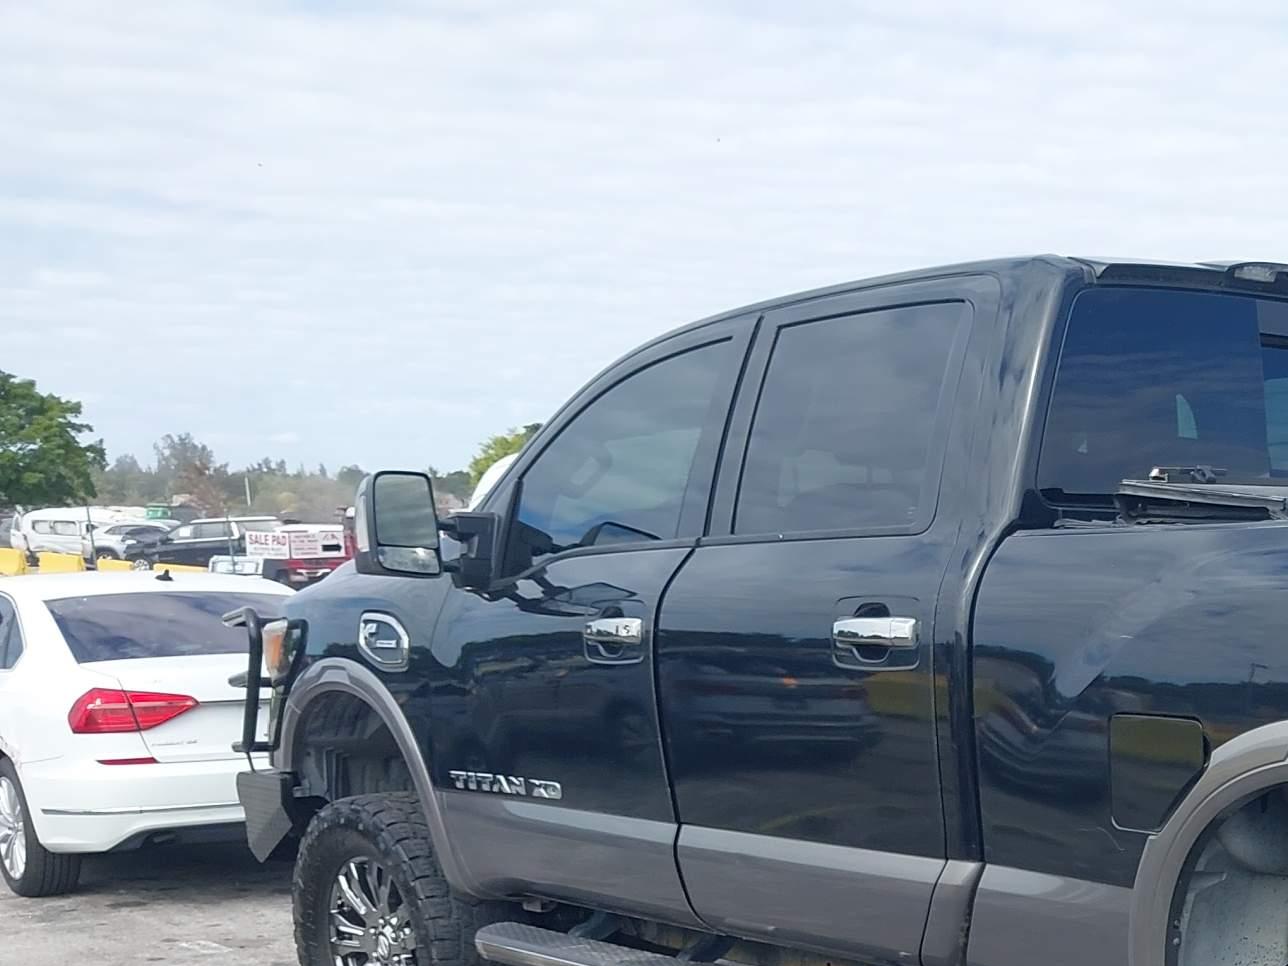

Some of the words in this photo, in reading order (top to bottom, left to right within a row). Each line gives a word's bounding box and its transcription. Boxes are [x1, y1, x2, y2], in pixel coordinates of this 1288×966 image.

[248, 533, 270, 546] SALE
[449, 770, 527, 796] TITAN
[527, 779, 562, 800] XD
